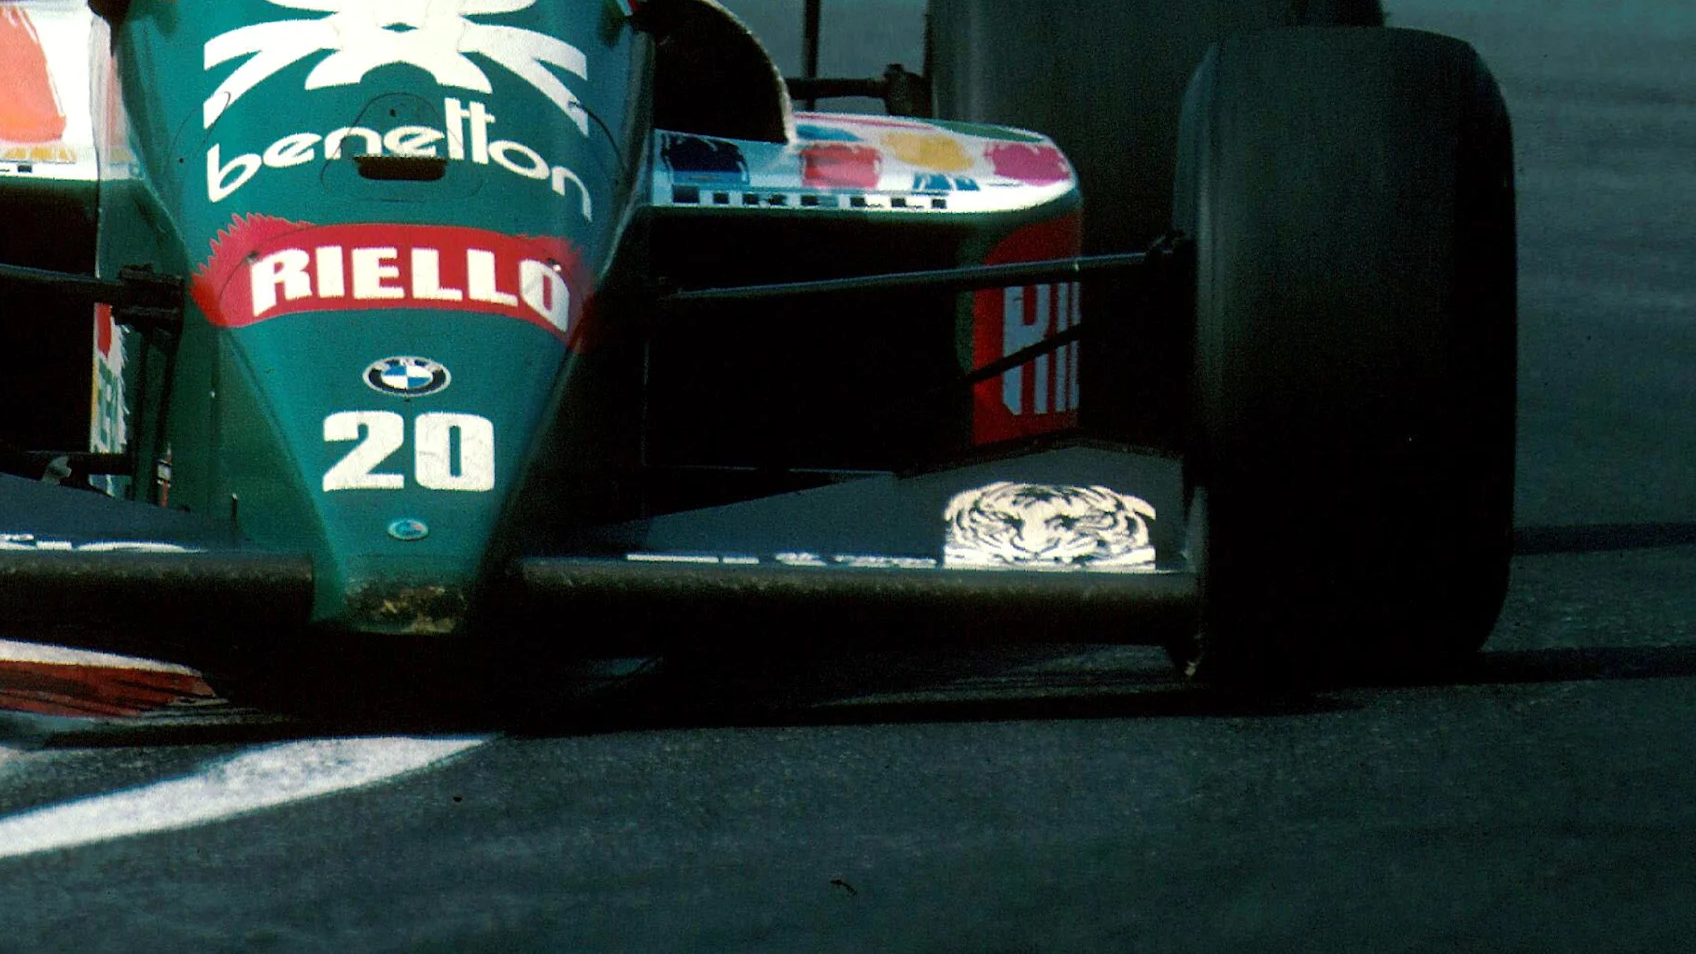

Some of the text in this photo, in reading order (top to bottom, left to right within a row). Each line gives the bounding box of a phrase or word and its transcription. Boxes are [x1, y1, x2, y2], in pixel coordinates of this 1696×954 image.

[206, 97, 592, 221] benetton
[251, 245, 569, 333] RIELLO
[323, 410, 495, 492] 20
